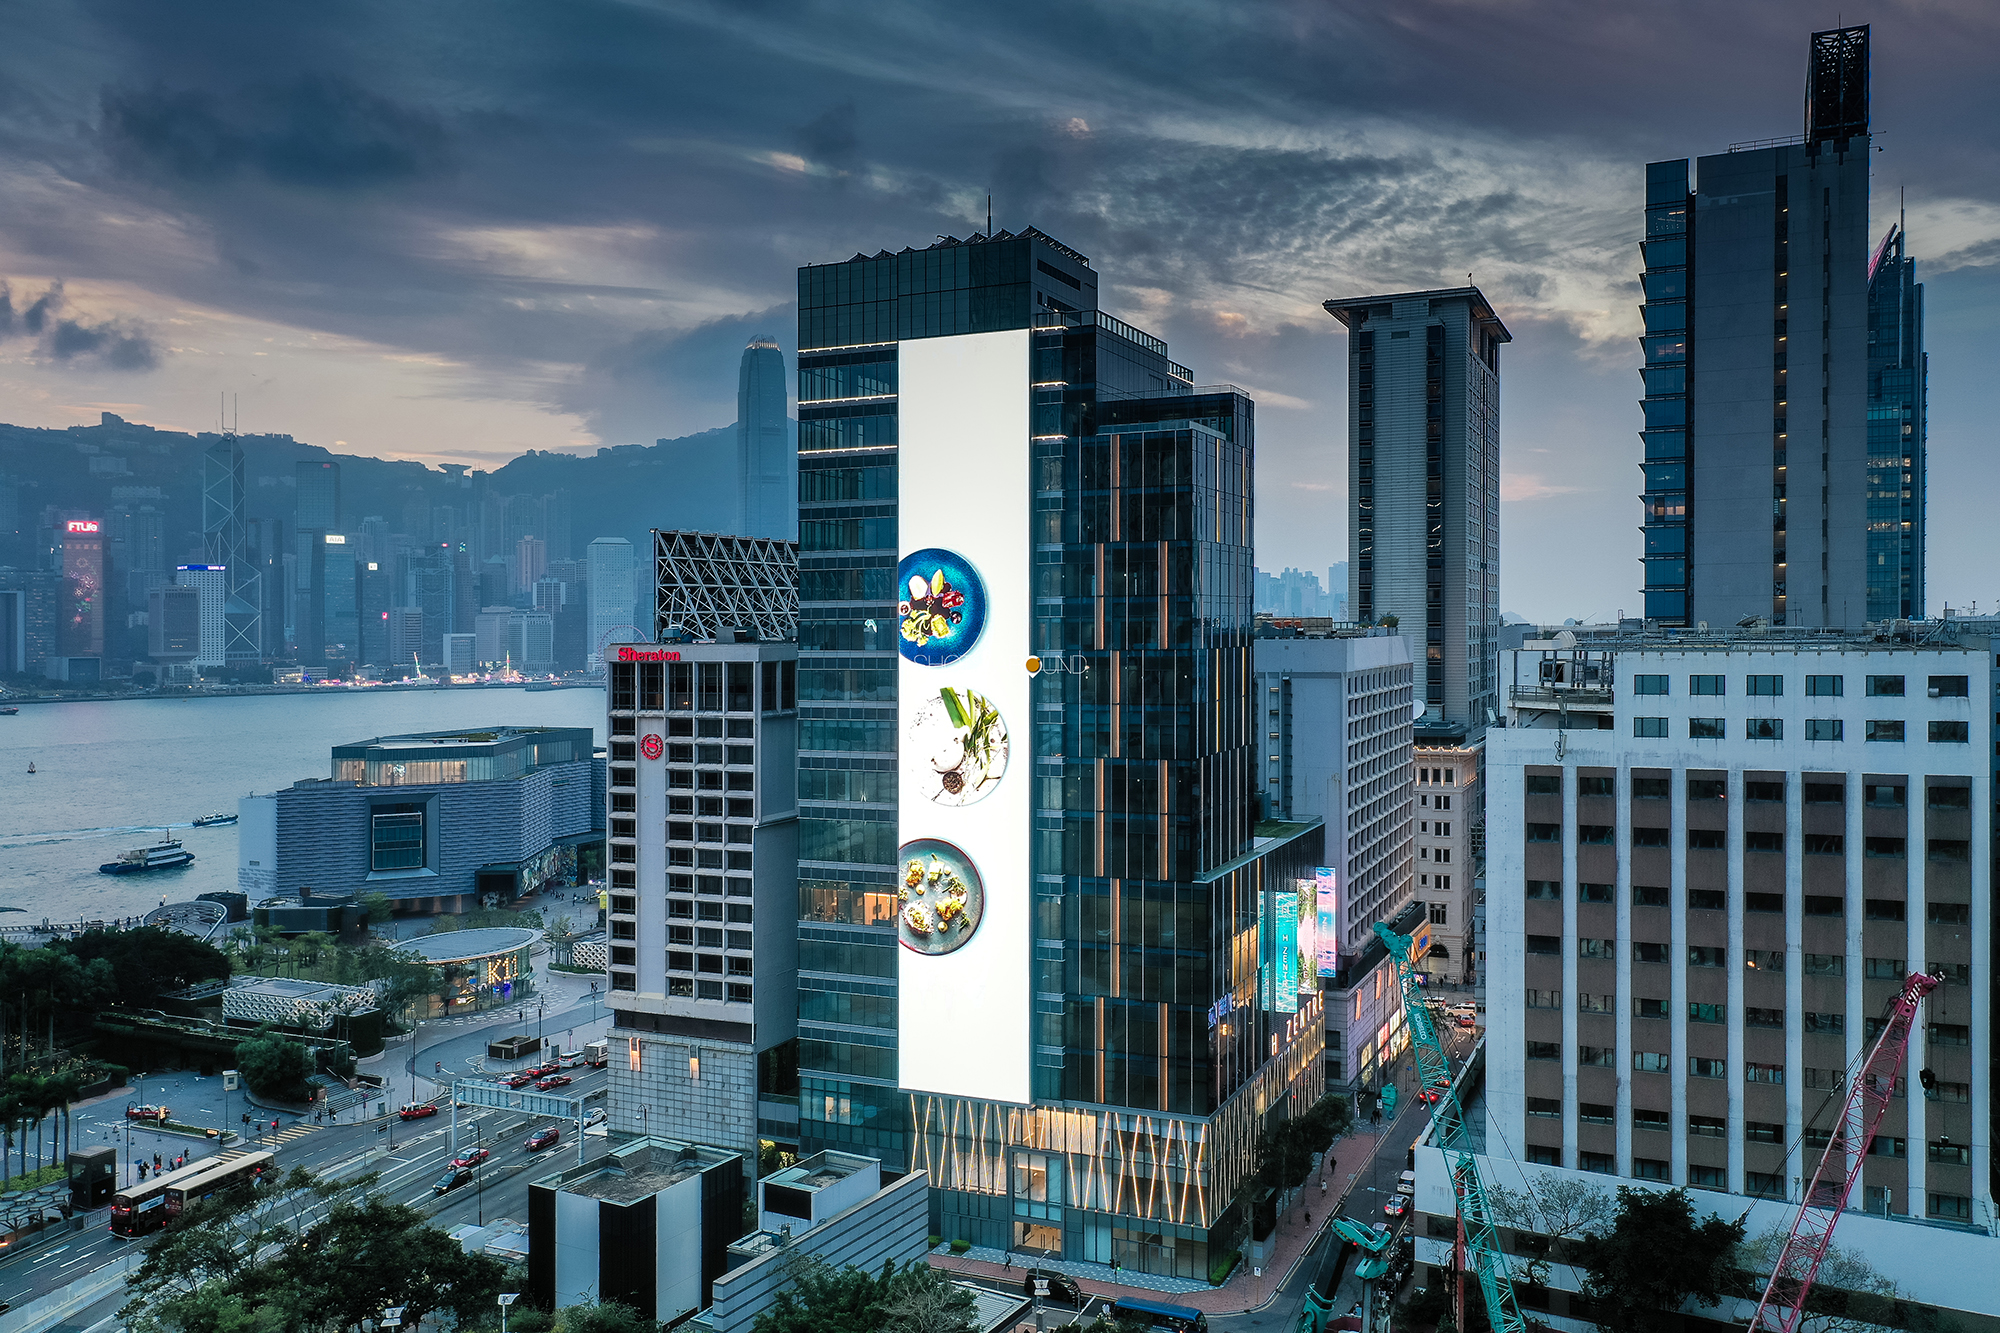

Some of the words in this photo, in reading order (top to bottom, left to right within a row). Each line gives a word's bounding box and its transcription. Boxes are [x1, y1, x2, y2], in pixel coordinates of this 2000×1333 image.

[618, 647, 681, 661] Sheraton
[487, 955, 519, 984] K11
[1271, 1032, 1279, 1057] H
[1286, 989, 1325, 1043] ZENTRE
